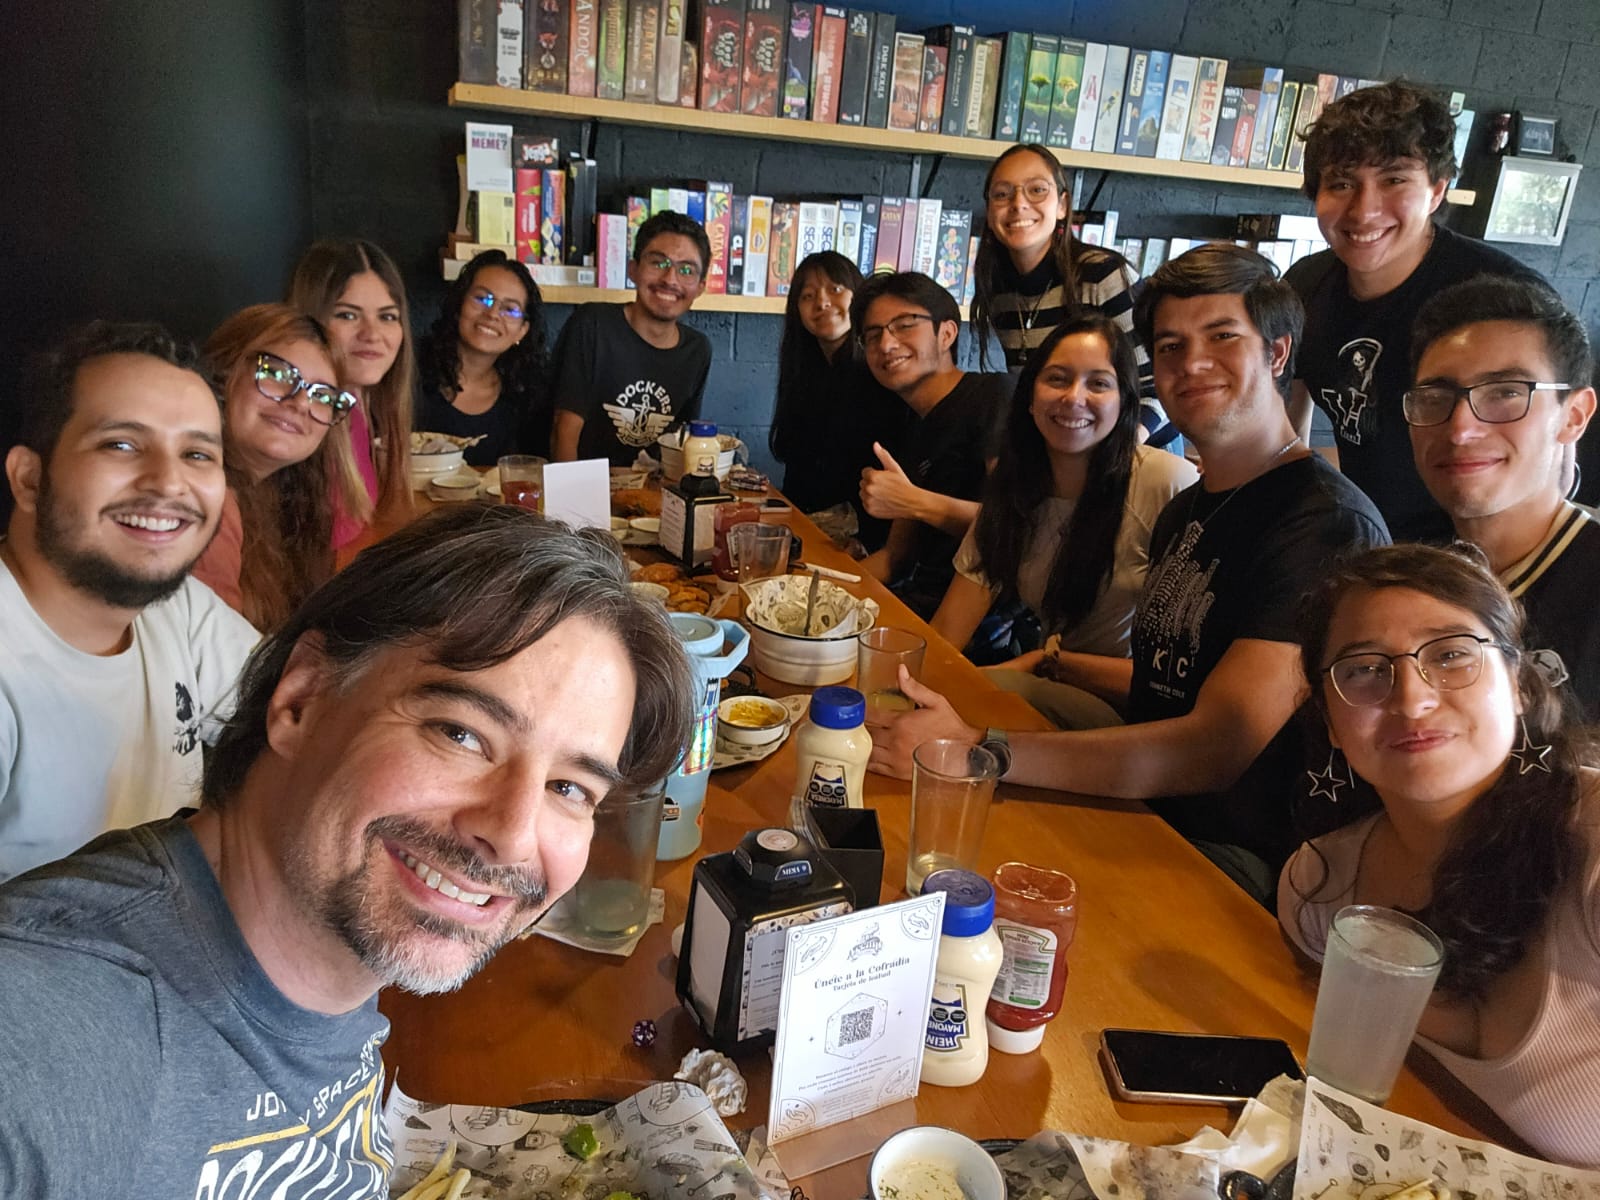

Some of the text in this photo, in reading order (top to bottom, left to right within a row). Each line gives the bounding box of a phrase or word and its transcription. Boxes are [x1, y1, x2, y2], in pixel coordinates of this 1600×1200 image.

[881, 45, 889, 70] DARK
[877, 70, 886, 99] SOULS
[1197, 81, 1218, 141] HEAT
[471, 138, 508, 150] MEME?
[713, 224, 725, 261] CATAN
[615, 380, 672, 414] DOCKERS
[1152, 648, 1189, 678] K C
[856, 969, 865, 978] la
[928, 1020, 961, 1033] MAYONE
[926, 1034, 954, 1047] HEIN
